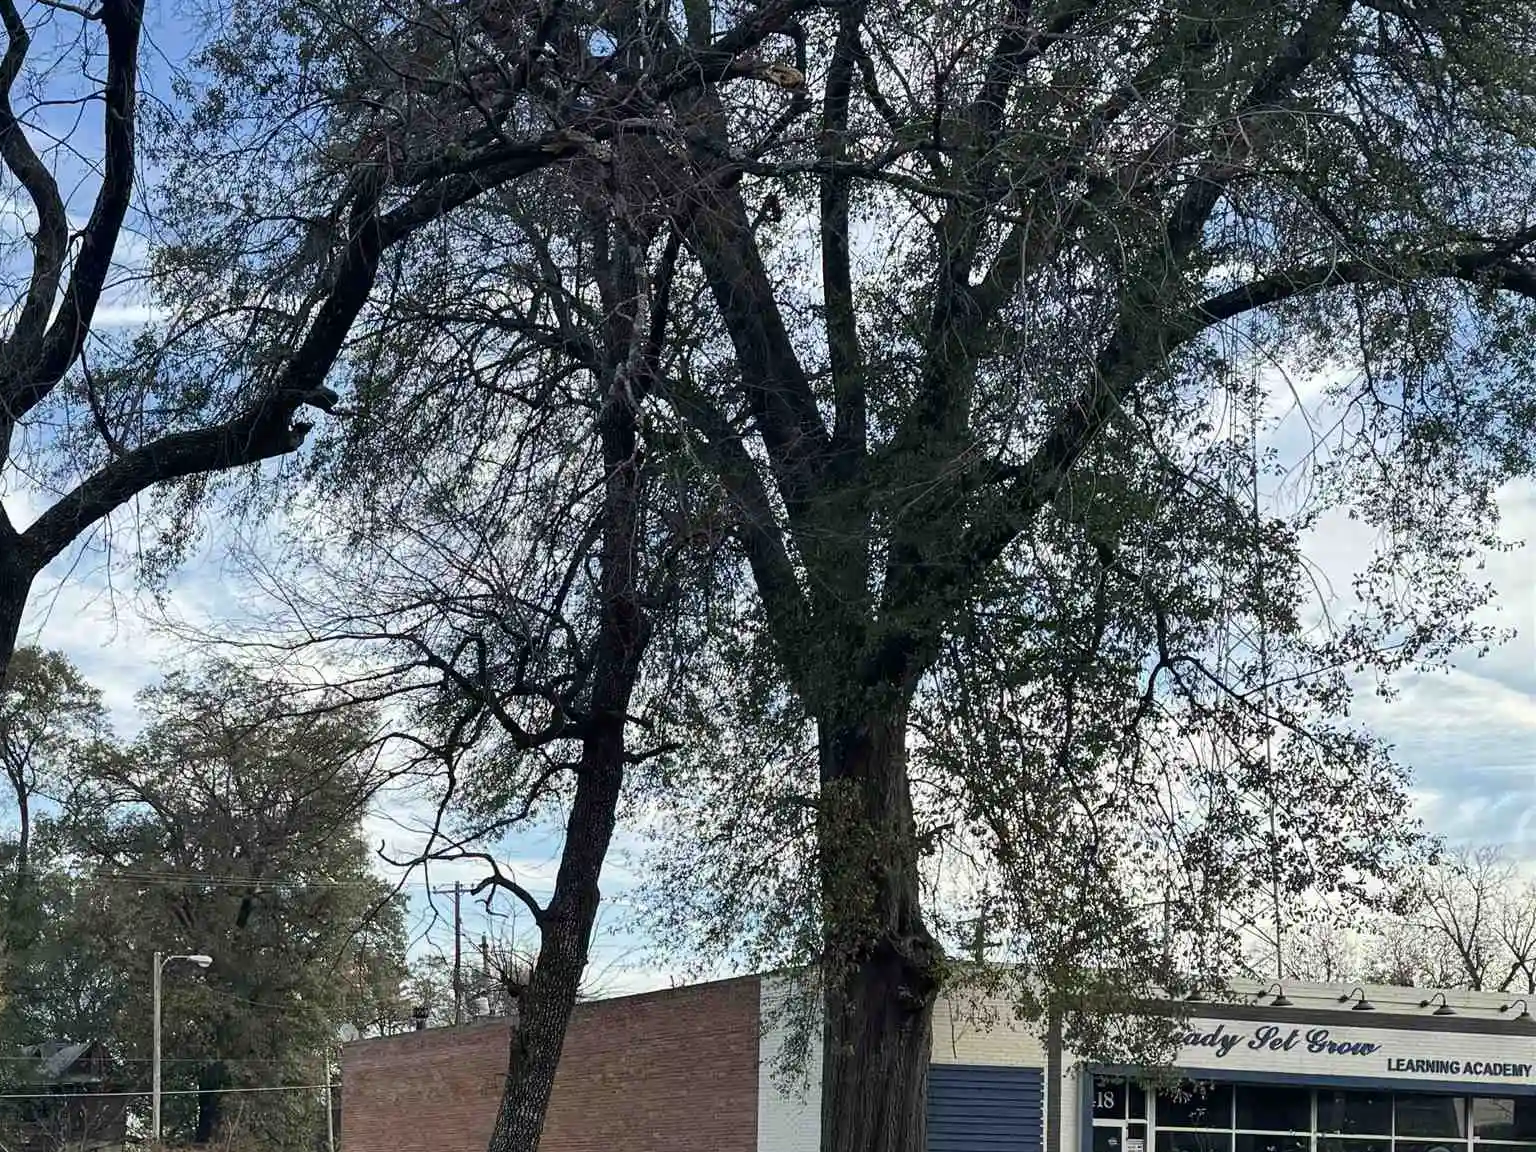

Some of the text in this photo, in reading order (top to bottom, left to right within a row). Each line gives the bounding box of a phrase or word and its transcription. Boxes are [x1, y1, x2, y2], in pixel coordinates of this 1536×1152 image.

[1247, 1025, 1300, 1051] Set
[1305, 1029, 1382, 1056] Grow
[1387, 1058, 1533, 1077] LEARNING ACADEMY
